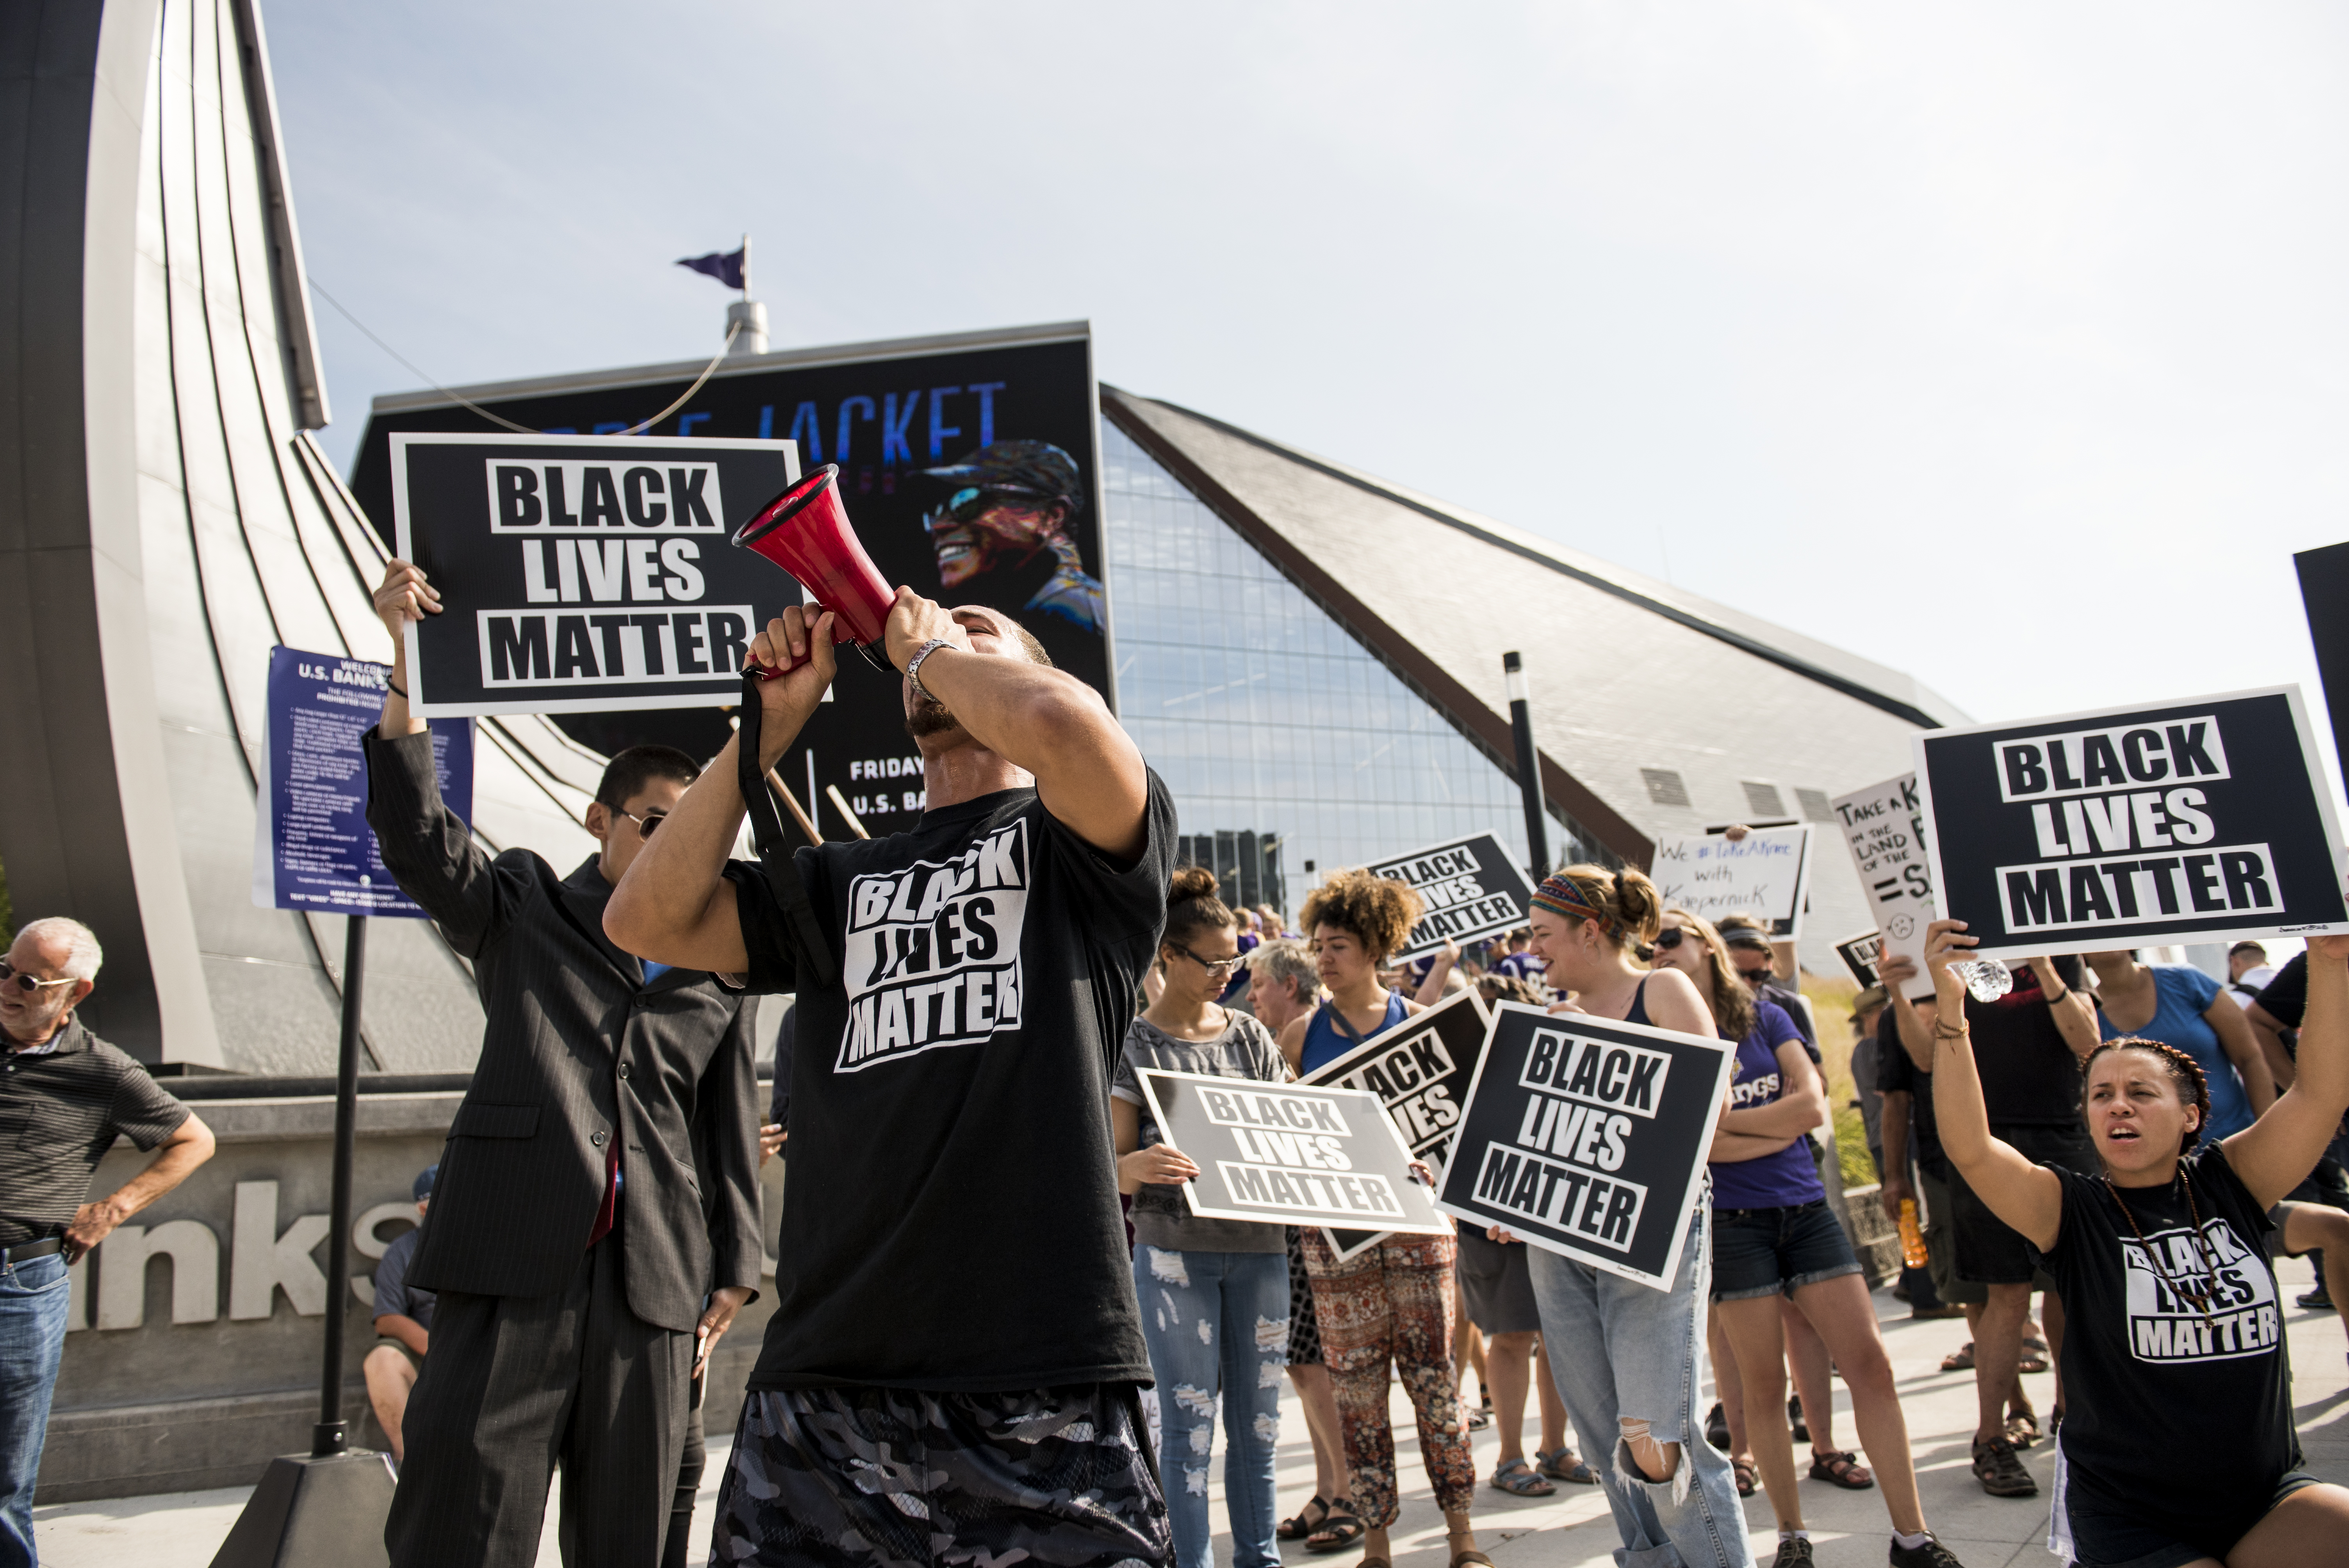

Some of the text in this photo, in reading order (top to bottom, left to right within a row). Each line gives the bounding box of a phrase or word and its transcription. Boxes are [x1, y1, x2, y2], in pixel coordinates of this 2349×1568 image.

[497, 461, 715, 527] BLACK
[522, 538, 705, 602] LIVES
[488, 612, 748, 680] MATTER
[299, 663, 330, 681] U.S.
[333, 668, 377, 690] BANK
[328, 686, 342, 695] THE
[342, 689, 383, 701] FOLLOWING
[317, 692, 382, 710] PROHIBITED INSIDE
[850, 755, 924, 780] FRIDAY
[2002, 721, 2220, 796] BLACK
[853, 790, 925, 815] U.S. BA
[1836, 798, 1886, 827] TAKE
[2031, 788, 2215, 857] LIVES
[1659, 837, 1689, 862] We
[1857, 833, 1907, 861] LAND
[1869, 823, 1893, 840] THE
[855, 829, 1021, 928] BLACK
[1381, 847, 1476, 886] BLACK
[1695, 865, 1732, 883] with
[1864, 848, 1910, 872] OF THE
[378, 900, 406, 909] LOCATION
[1420, 874, 1484, 914] IVES
[2006, 851, 2274, 928] MATTER
[866, 896, 998, 987] LIES
[1409, 897, 1515, 944] MATTER
[848, 963, 1017, 1062] MATTER
[1340, 1033, 1451, 1104] ACK
[1526, 1034, 1664, 1111] BLACK
[1204, 1090, 1343, 1131] BLACK
[1392, 1084, 1460, 1146] VES
[1517, 1094, 1631, 1171] LIVES
[1231, 1127, 1352, 1171] LIVES
[1227, 1166, 1397, 1212] MATTER
[1480, 1148, 1637, 1244] MATTER
[67, 1180, 422, 1332] nks
[2126, 1225, 2249, 1276] BLACK
[2153, 1269, 2255, 1313] LIVES
[2136, 1306, 2277, 1357] MATTER
